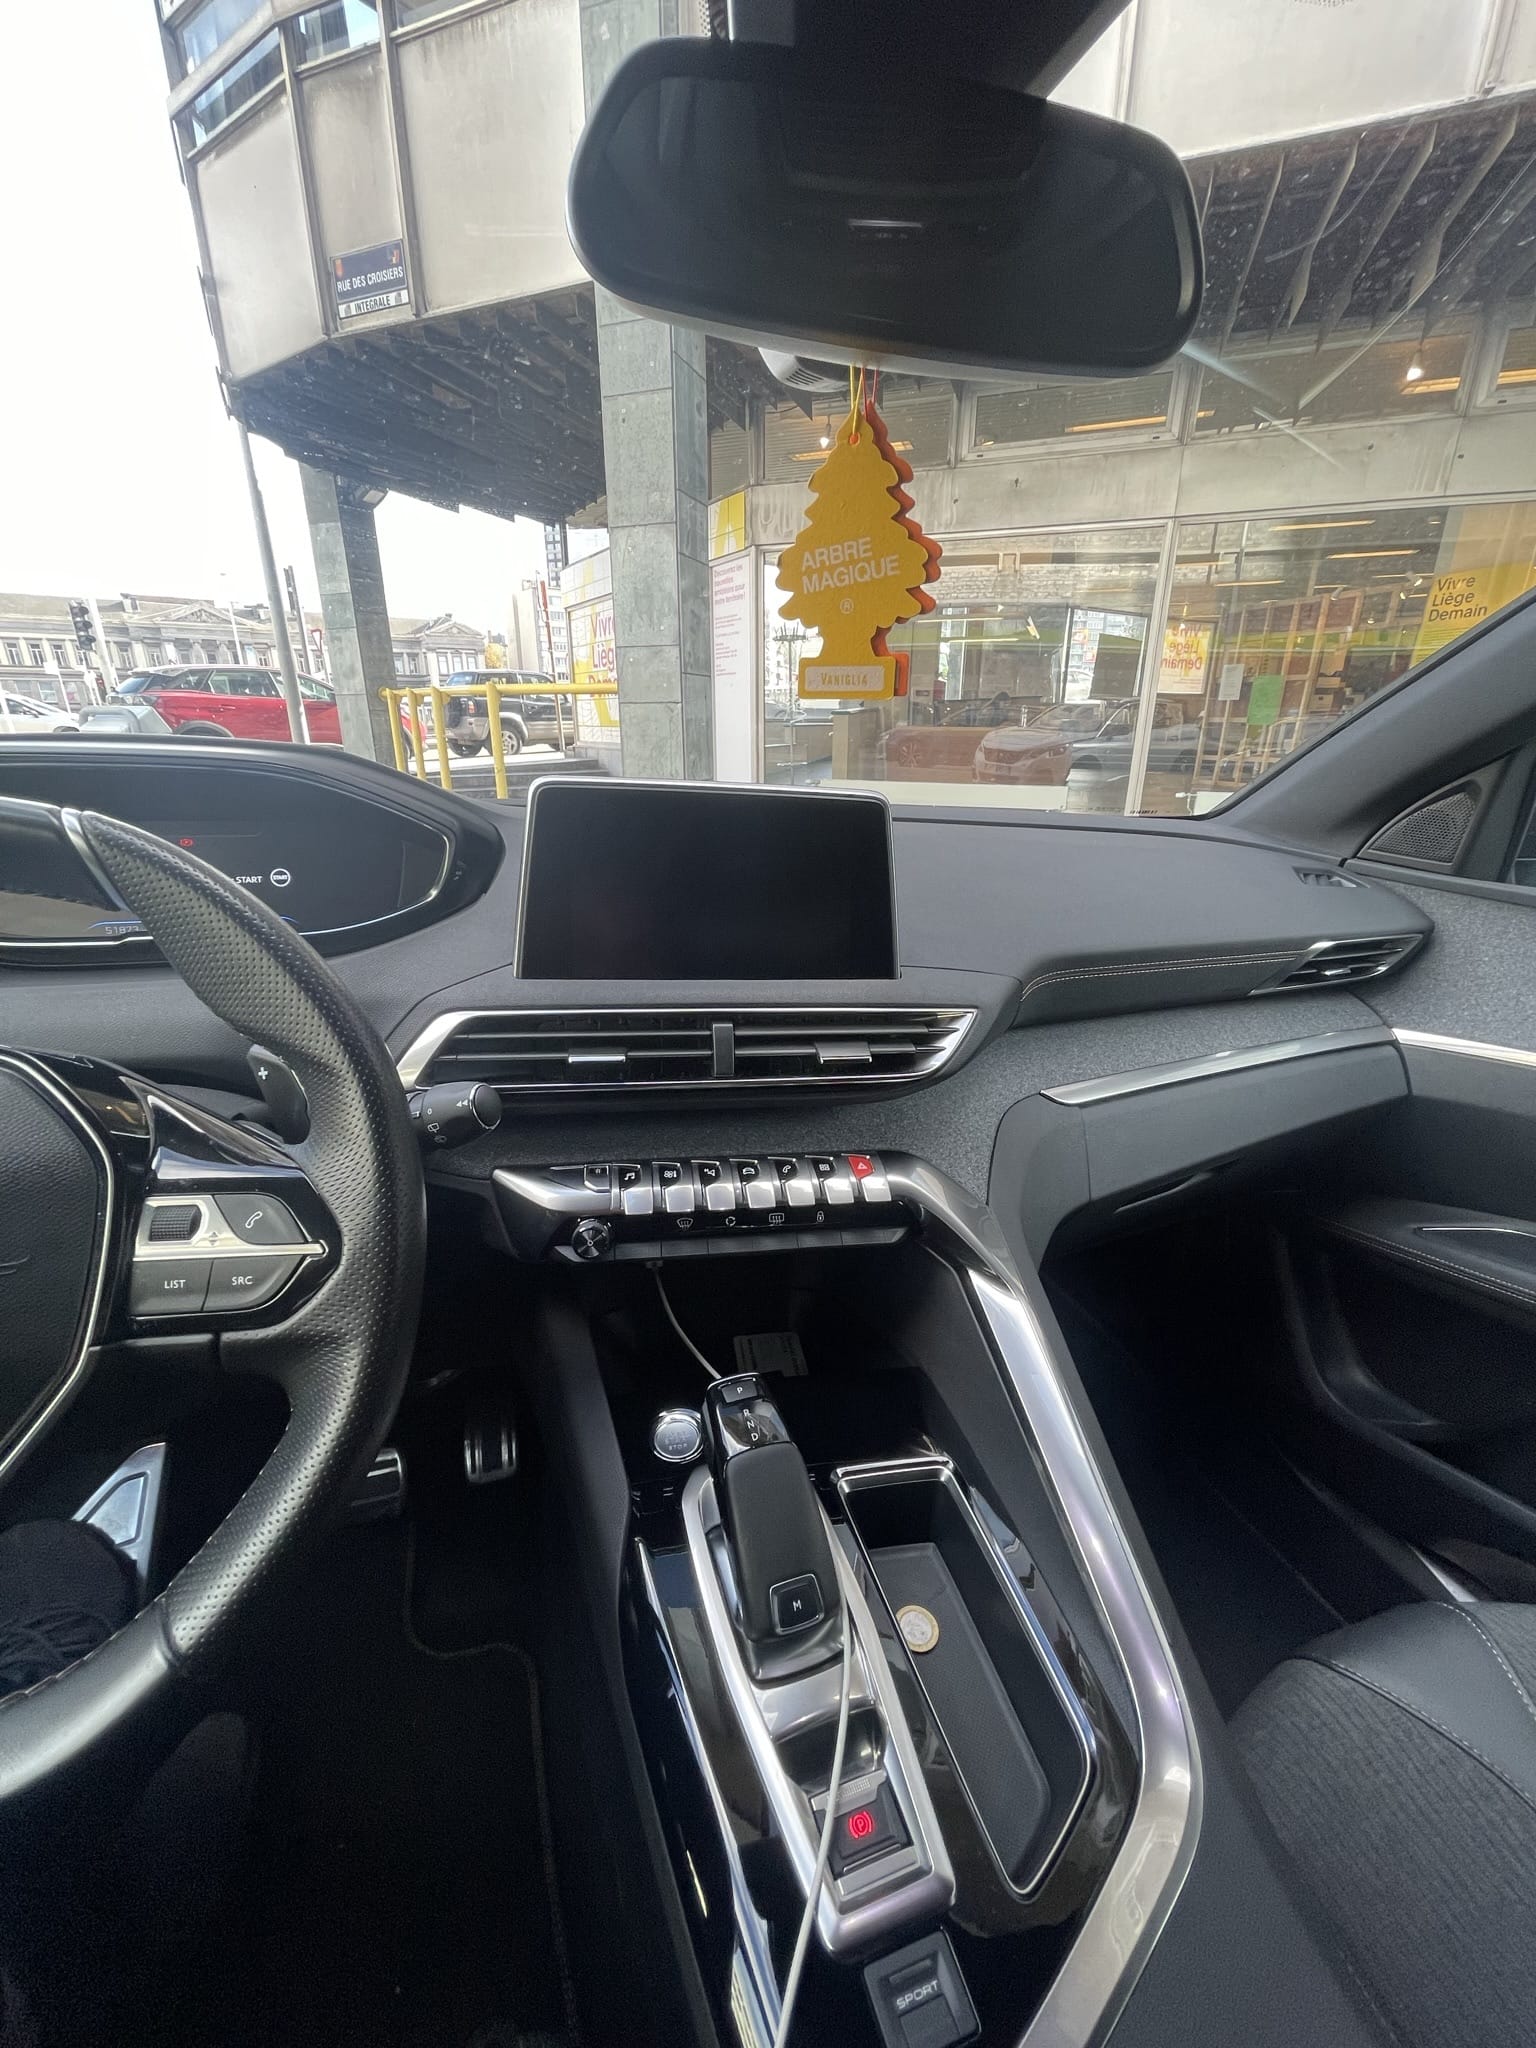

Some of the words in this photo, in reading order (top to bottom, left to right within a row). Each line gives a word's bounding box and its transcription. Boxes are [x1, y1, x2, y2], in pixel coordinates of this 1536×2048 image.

[337, 279, 353, 293] RUE
[352, 275, 366, 289] DES
[367, 266, 404, 285] CROISIERS
[801, 537, 873, 572] ARBRE
[802, 554, 901, 595] MAGIQUE
[1438, 576, 1476, 592] Vivre
[1432, 592, 1475, 608] Liège
[1428, 604, 1488, 622] Demain
[821, 672, 868, 687] VANIGLIA
[235, 875, 263, 884] START
[164, 1279, 187, 1289] LIST
[231, 1275, 253, 1286] SRC
[743, 1409, 750, 1417] R
[746, 1420, 755, 1429] N
[751, 1433, 759, 1441] D
[792, 1599, 802, 1612] M
[896, 1979, 939, 2010] SPORT
